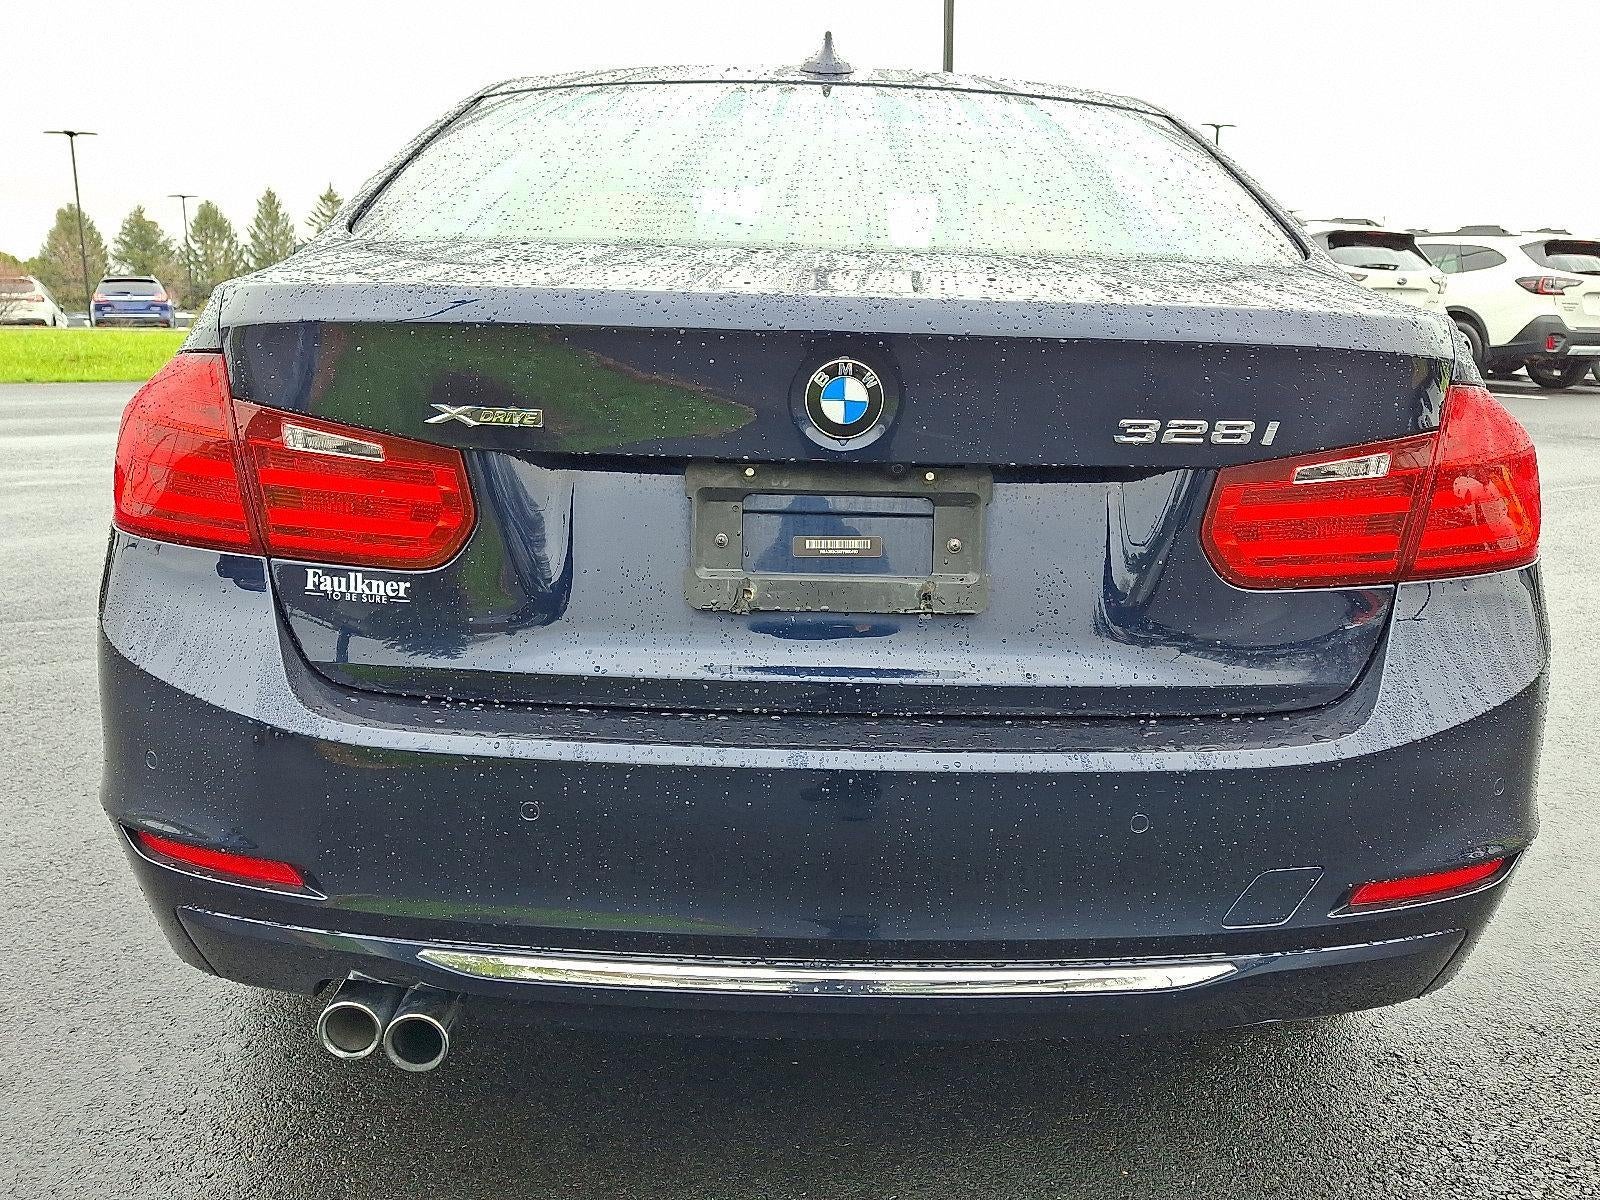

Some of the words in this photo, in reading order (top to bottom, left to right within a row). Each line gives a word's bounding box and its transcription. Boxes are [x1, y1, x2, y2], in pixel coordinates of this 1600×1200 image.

[813, 362, 878, 388] BMW
[304, 568, 411, 598] Faulkner
[326, 591, 341, 600] TO
[345, 592, 357, 602] BE
[361, 594, 388, 604] SURE
